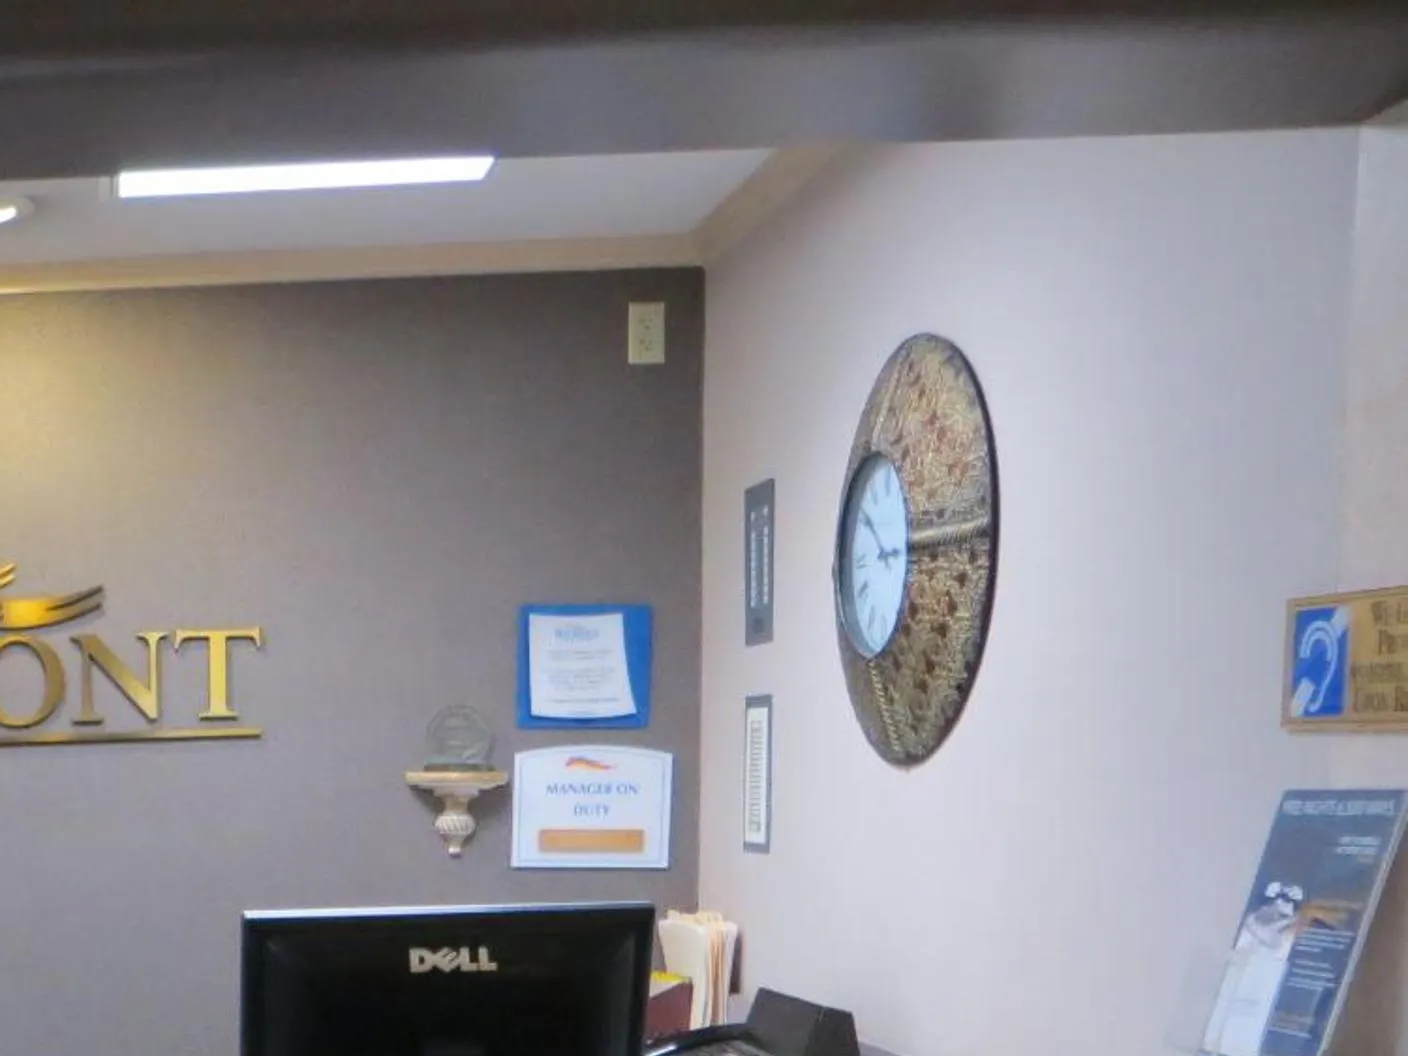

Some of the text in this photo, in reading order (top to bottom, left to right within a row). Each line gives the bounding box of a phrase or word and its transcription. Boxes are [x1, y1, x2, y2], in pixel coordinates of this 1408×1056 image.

[545, 782, 639, 796] MANAGER ON
[574, 803, 611, 817] DUTY
[408, 946, 498, 973] DELL
